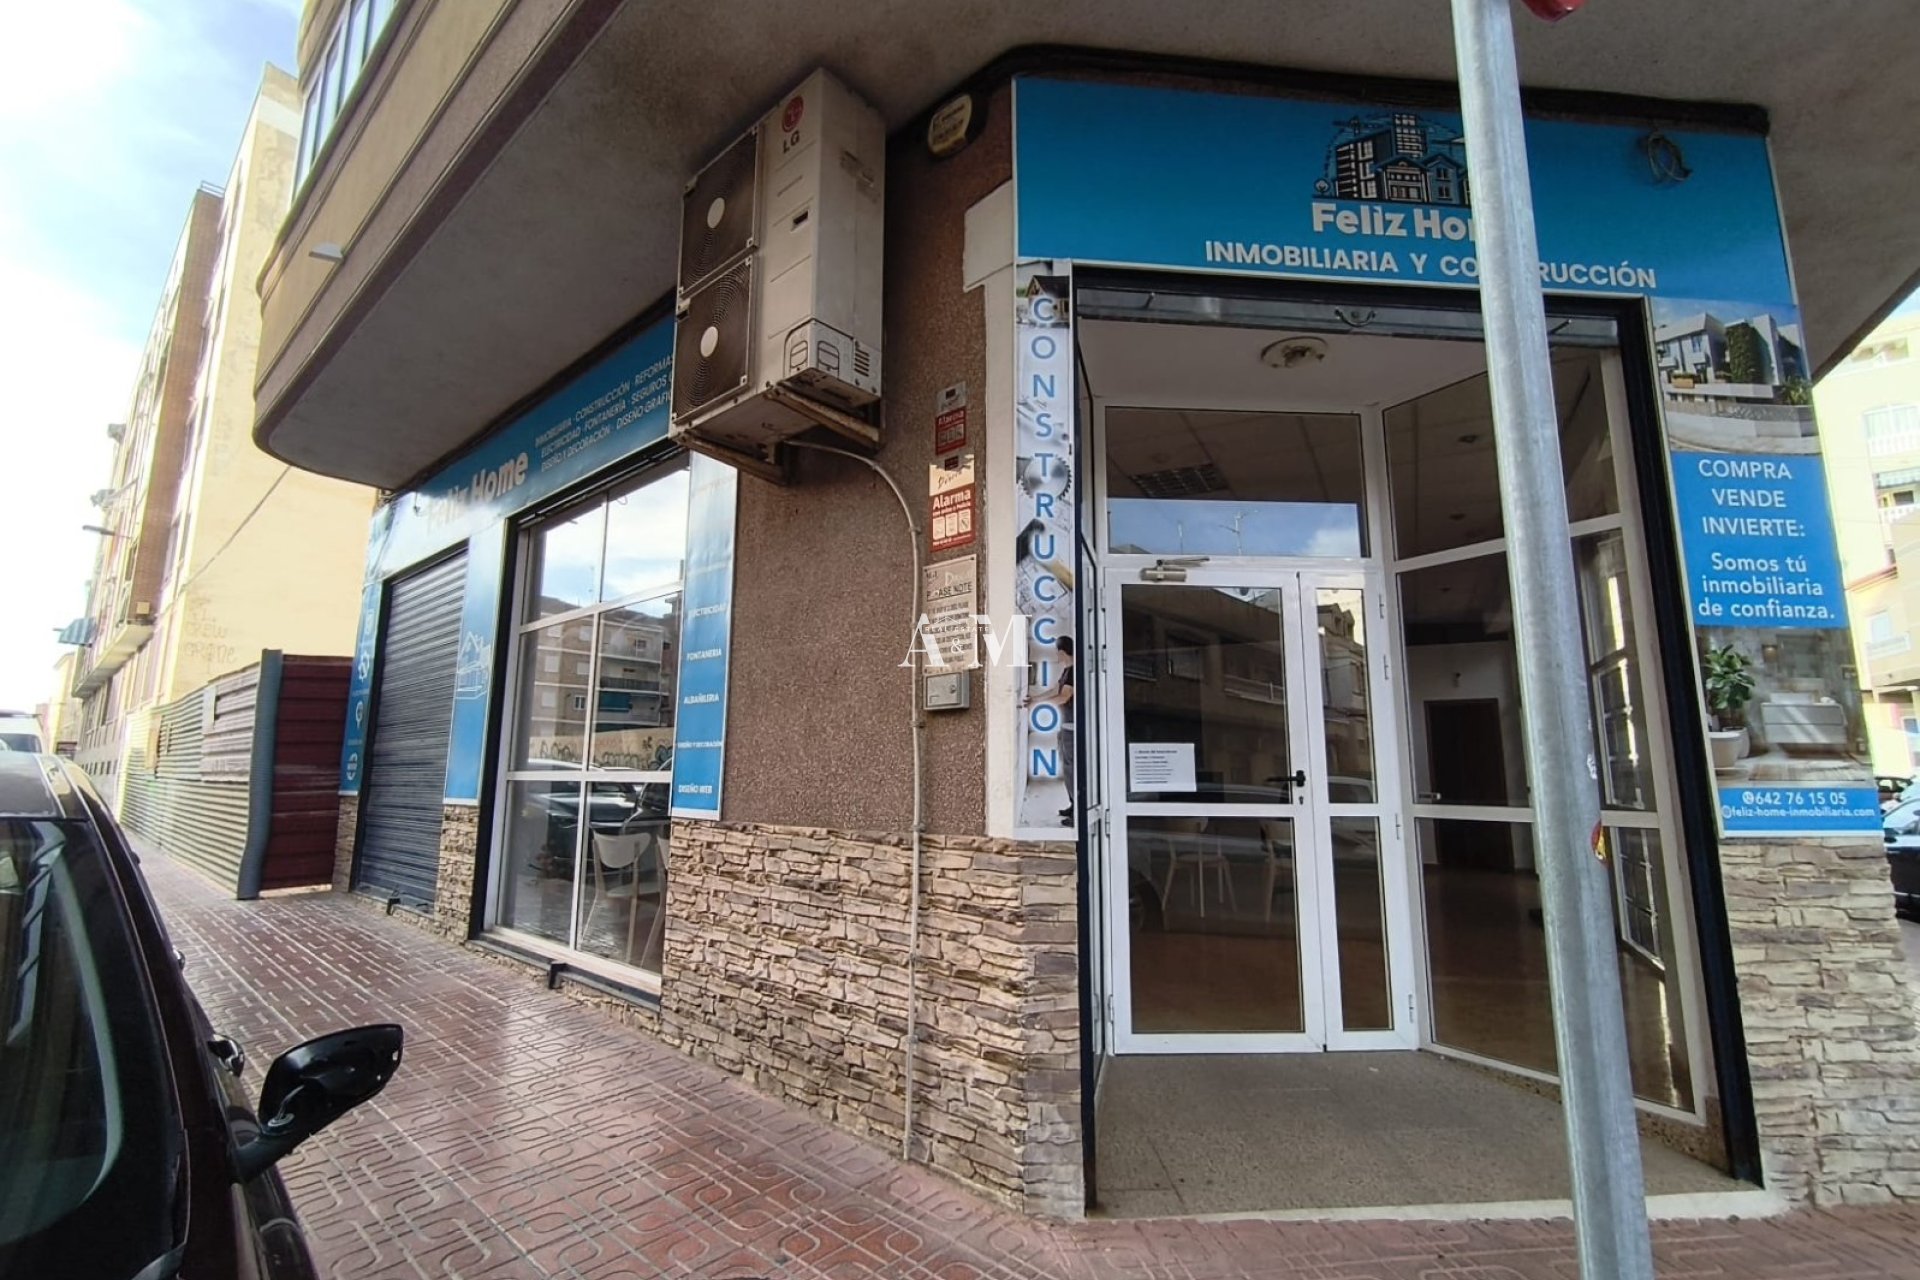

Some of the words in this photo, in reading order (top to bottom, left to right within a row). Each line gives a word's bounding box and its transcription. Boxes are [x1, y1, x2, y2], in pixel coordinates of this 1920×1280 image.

[782, 130, 800, 154] LG
[1311, 202, 1407, 238] Feliz
[1414, 207, 1476, 242] Ho
[1204, 240, 1399, 273] INMOBILIARIA
[1410, 253, 1429, 274] Y
[1440, 255, 1656, 289] CORUCCIÓN
[631, 374, 667, 405] SEGUROS
[472, 452, 529, 501] Home
[1698, 459, 1793, 480] COMPRA
[932, 489, 971, 510] Alarma
[1711, 488, 1787, 508] VENDE
[1702, 516, 1806, 537] INVIERTE:
[1711, 553, 1780, 572] Somos
[1786, 554, 1807, 573] tú
[1702, 575, 1824, 595] inmobiliaria
[1698, 597, 1723, 616] de
[1730, 598, 1836, 620] confianza.
[1755, 792, 1780, 805] 642
[1786, 792, 1804, 805] 76
[1808, 792, 1826, 805] 15
[1830, 792, 1848, 805] 05
